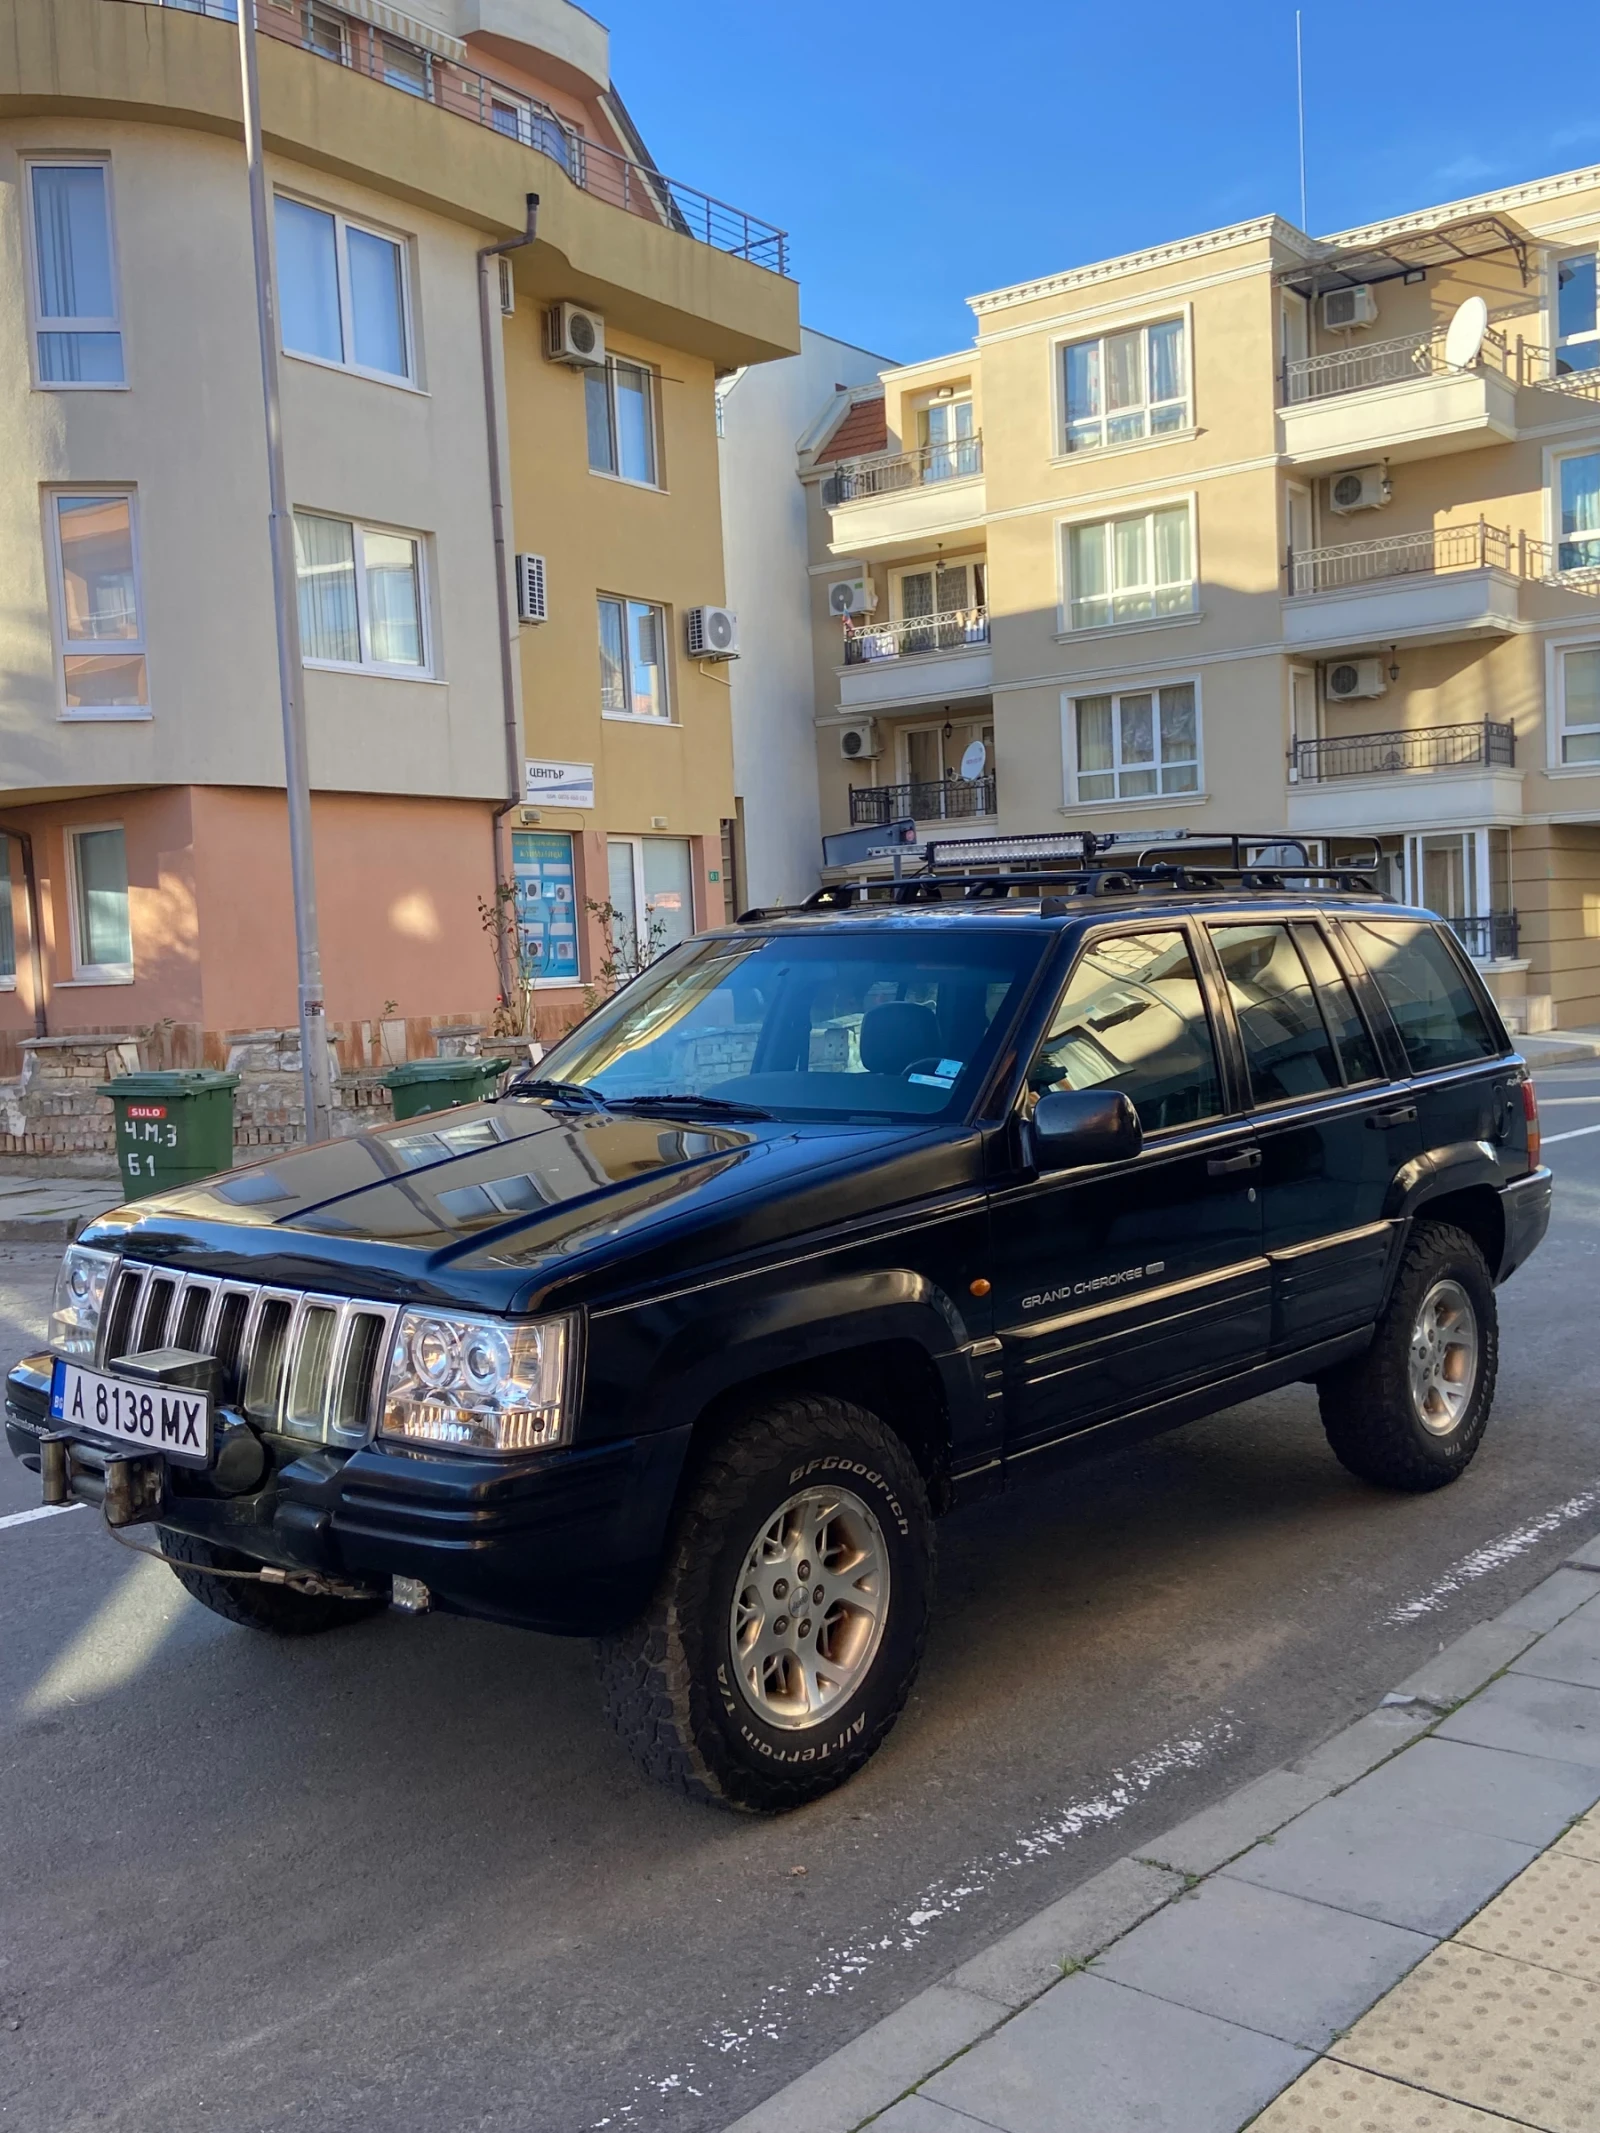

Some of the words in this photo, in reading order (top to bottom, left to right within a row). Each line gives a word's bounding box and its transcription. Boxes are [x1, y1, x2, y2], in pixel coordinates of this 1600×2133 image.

[529, 767, 564, 779] ЦЕНТЪР
[131, 1108, 160, 1117] SULO
[1021, 1286, 1071, 1309] GRAND
[1073, 1267, 1143, 1295] CHEROKEE
[54, 1395, 64, 1410] BG
[72, 1375, 84, 1419] A
[96, 1383, 154, 1437] 8138
[161, 1398, 200, 1447] MX
[788, 1455, 909, 1535] BFGoodrich
[716, 1663, 735, 1718] T/A
[740, 1711, 866, 1762] All-Terrain
